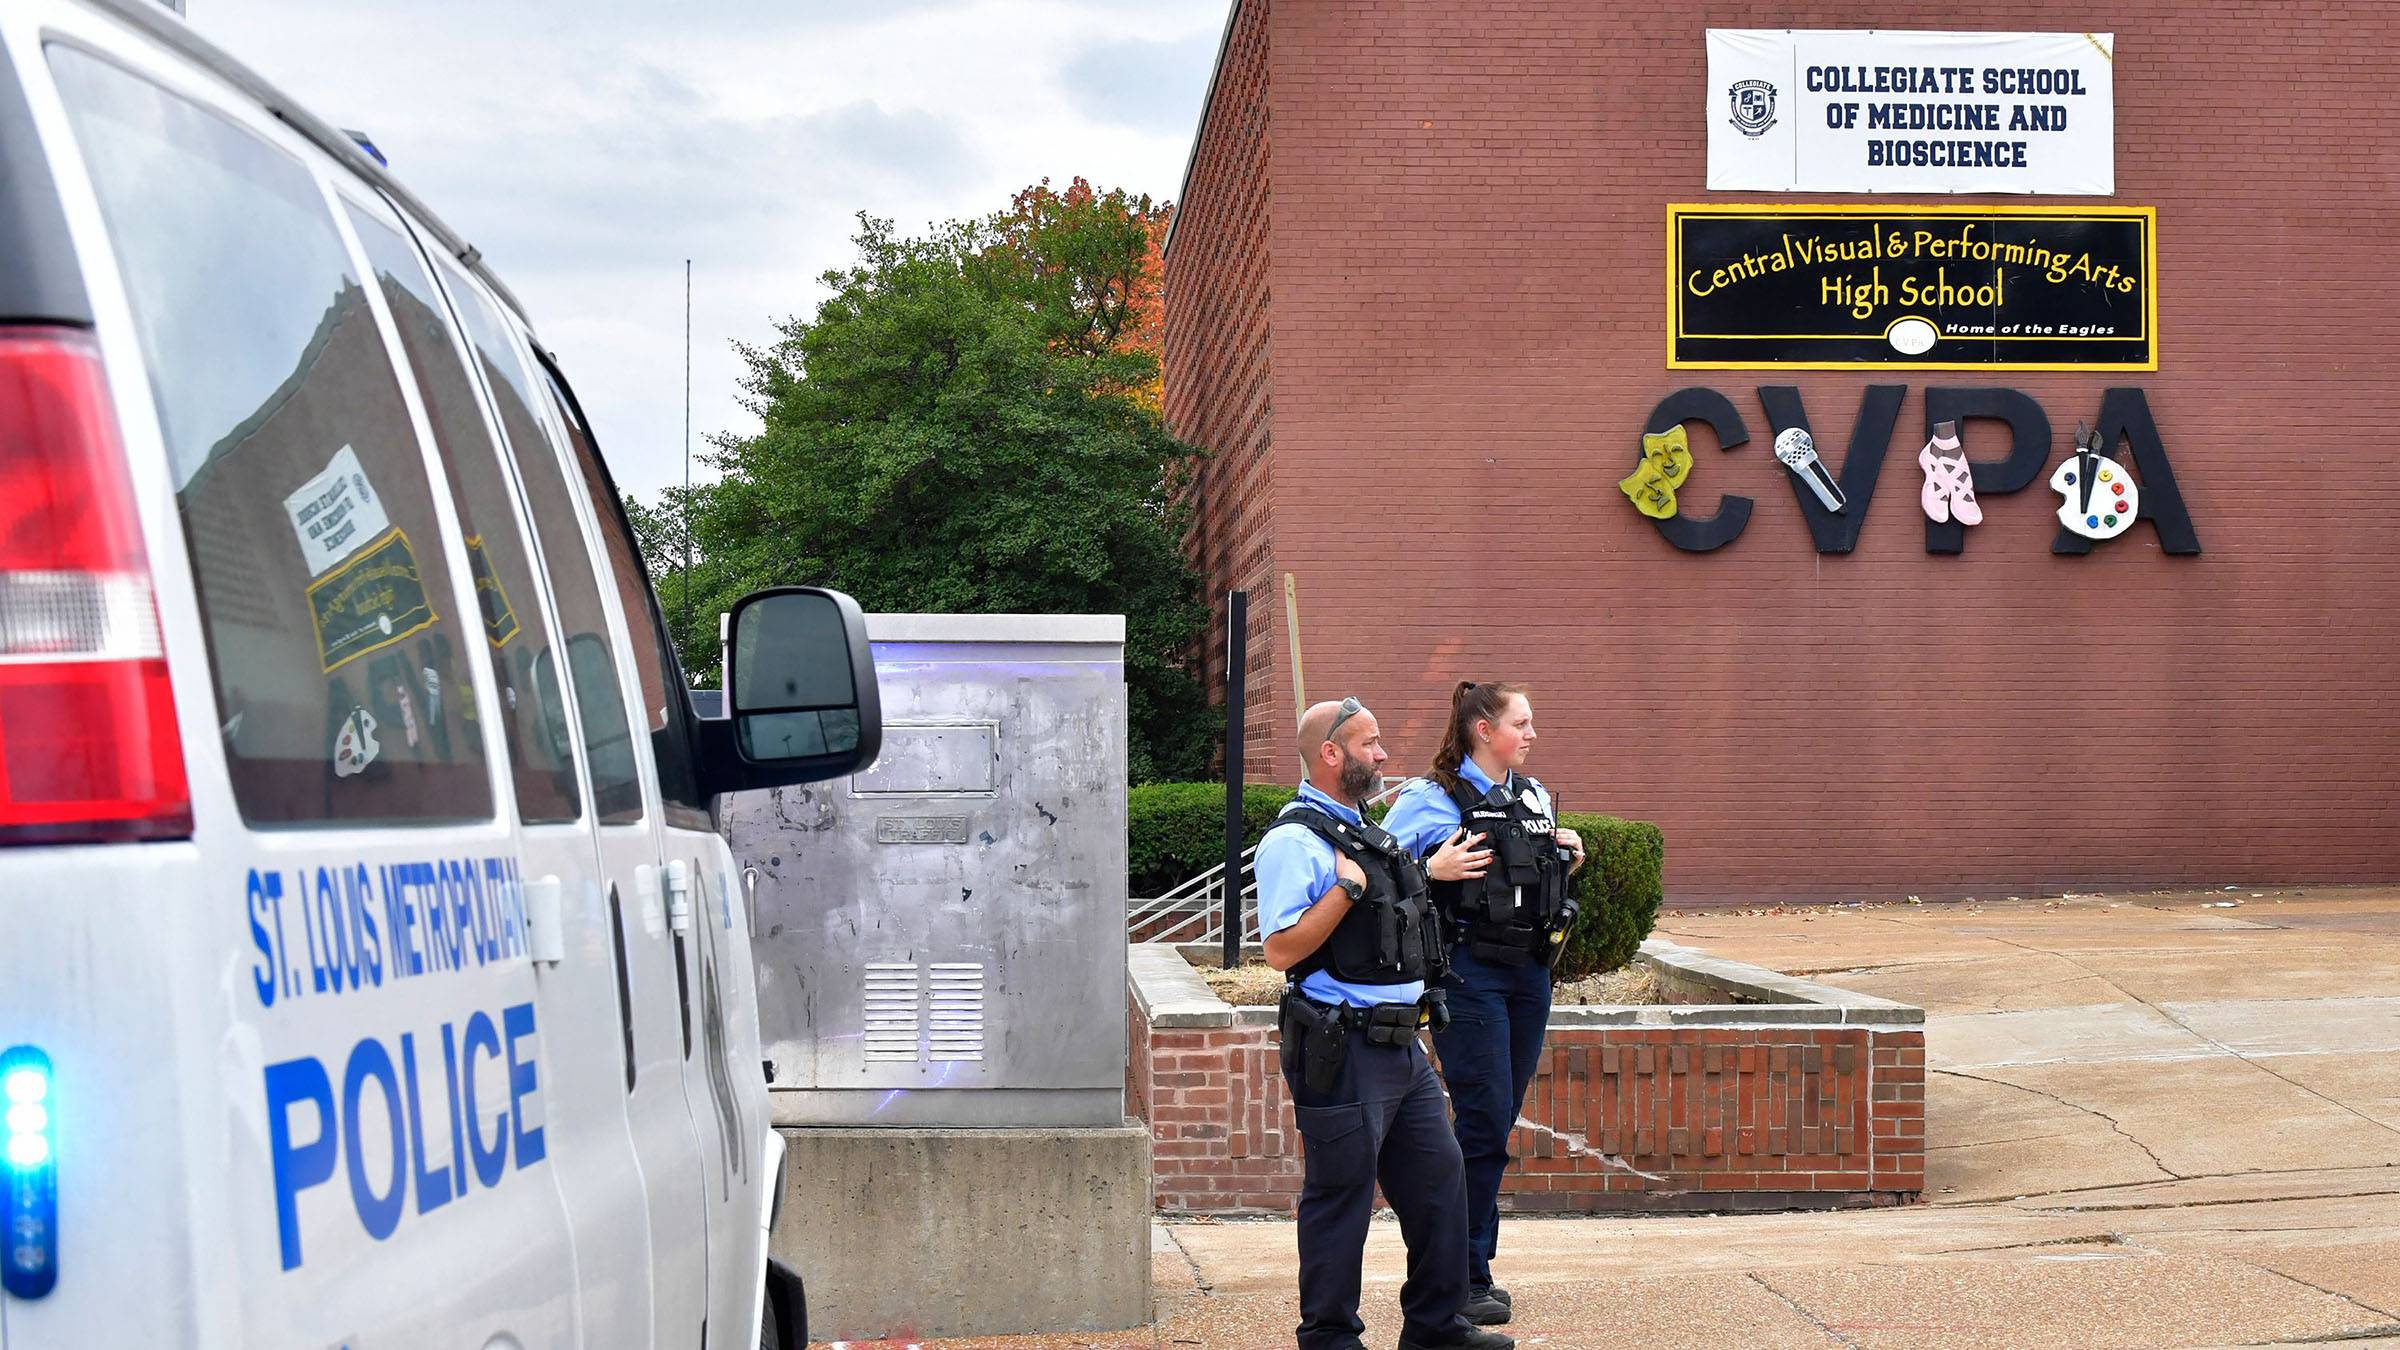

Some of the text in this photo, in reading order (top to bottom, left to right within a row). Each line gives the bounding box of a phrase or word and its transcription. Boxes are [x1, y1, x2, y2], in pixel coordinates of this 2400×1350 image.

[1806, 66, 2086, 95] COLLEGIATE SCHOOL
[1826, 103, 2067, 132] OF MEDICINE AND
[1867, 140, 2028, 168] BIOSCIENCE
[1688, 223, 2137, 297] Central Visual & Performing Arts
[1821, 266, 2004, 319] High School
[1946, 324, 2115, 336] Home of the Eagles
[1643, 384, 2200, 555] CVPA
[247, 857, 529, 1008] ST. LOUIS METROPOLITAN
[263, 1002, 546, 1273] POLICE
